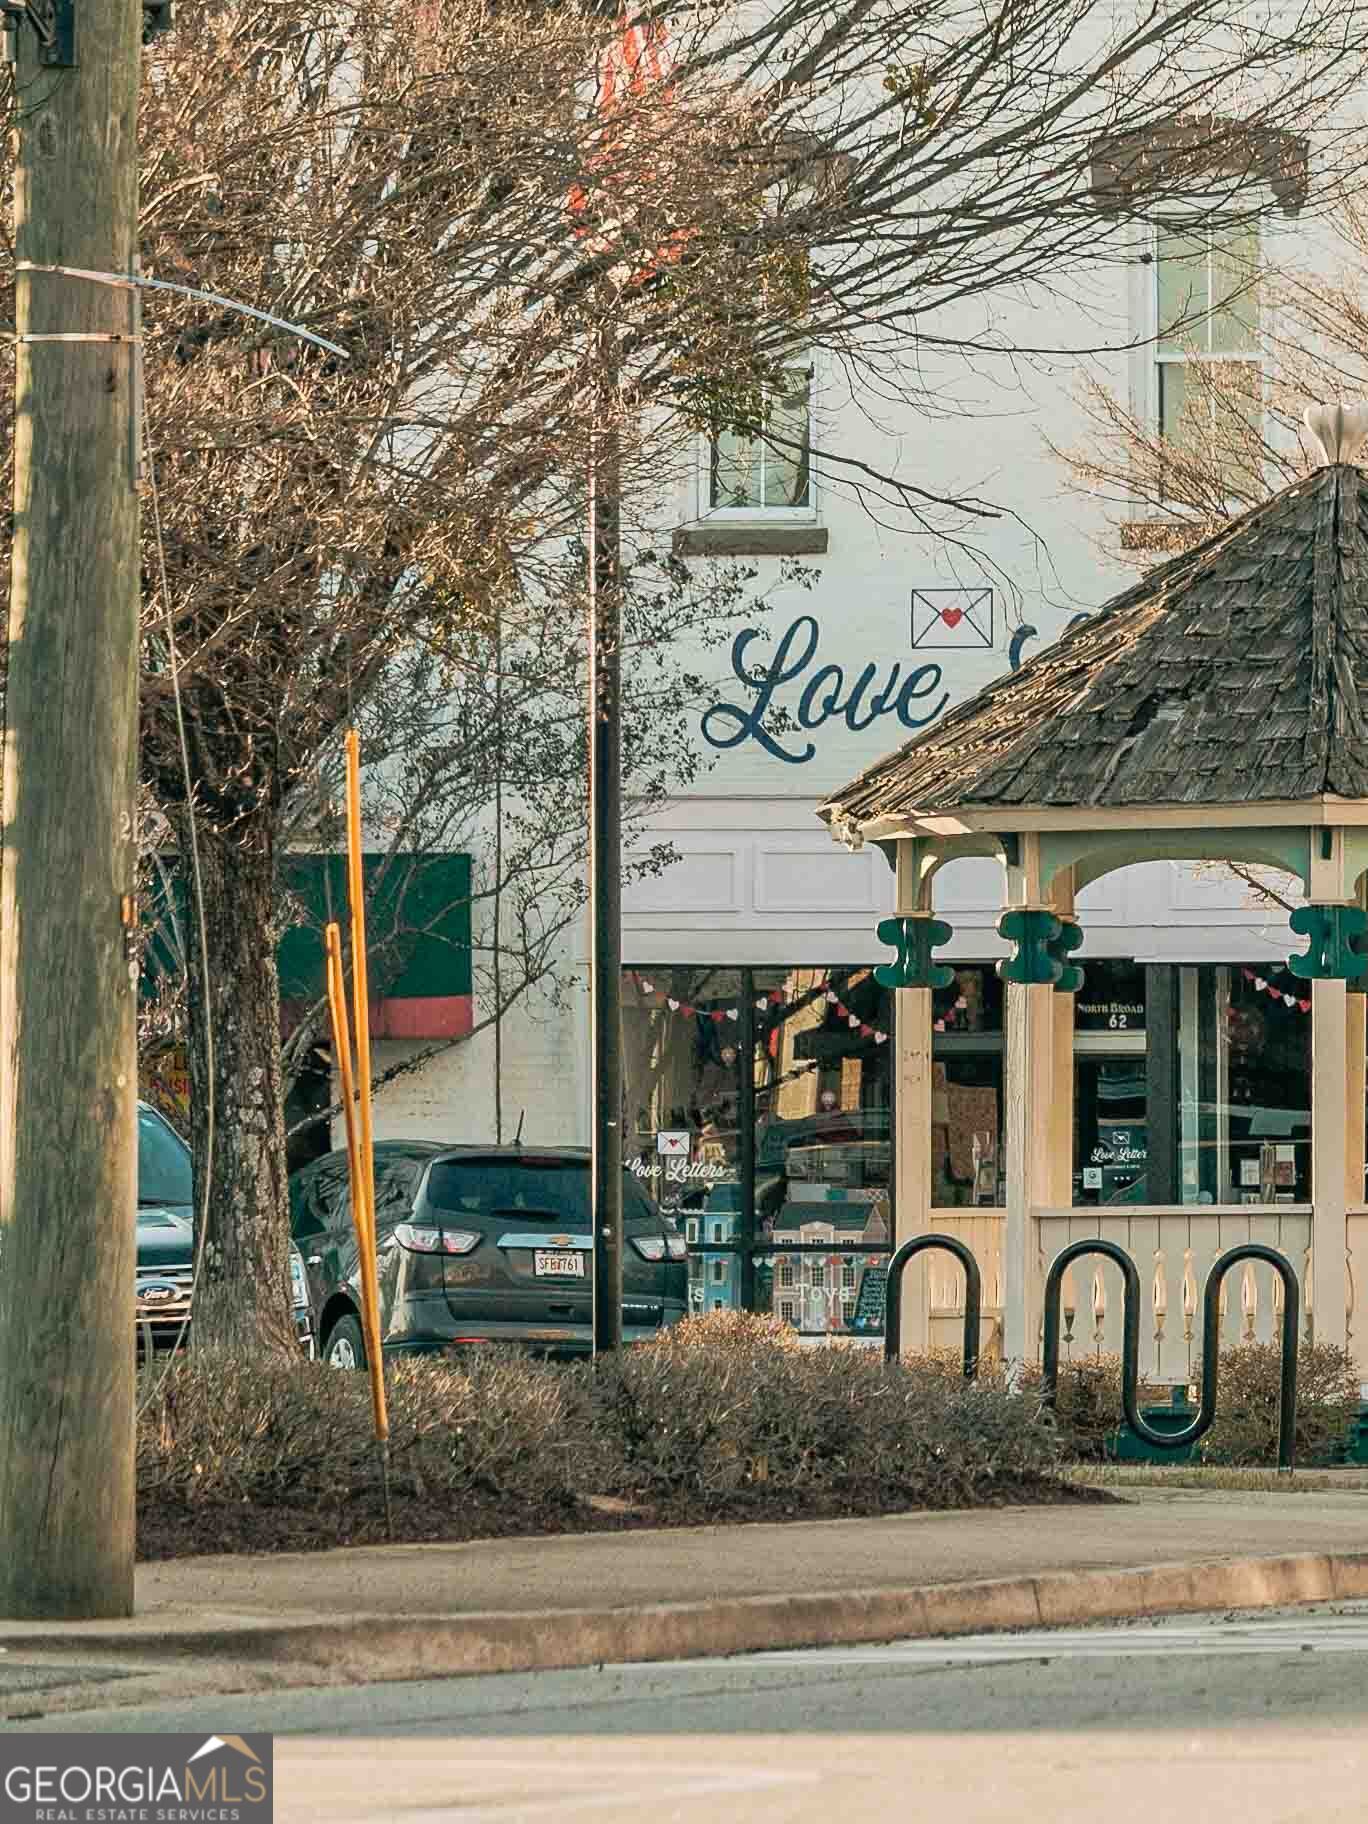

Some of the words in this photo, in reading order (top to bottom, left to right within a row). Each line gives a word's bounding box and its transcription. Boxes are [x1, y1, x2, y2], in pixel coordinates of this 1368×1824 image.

[701, 616, 950, 763] Love
[1110, 1002, 1144, 1013] BROAD
[1109, 1014, 1127, 1028] 62
[1090, 1147, 1114, 1162] Love
[665, 1158, 727, 1182] Letters
[797, 1283, 850, 1307] Toys
